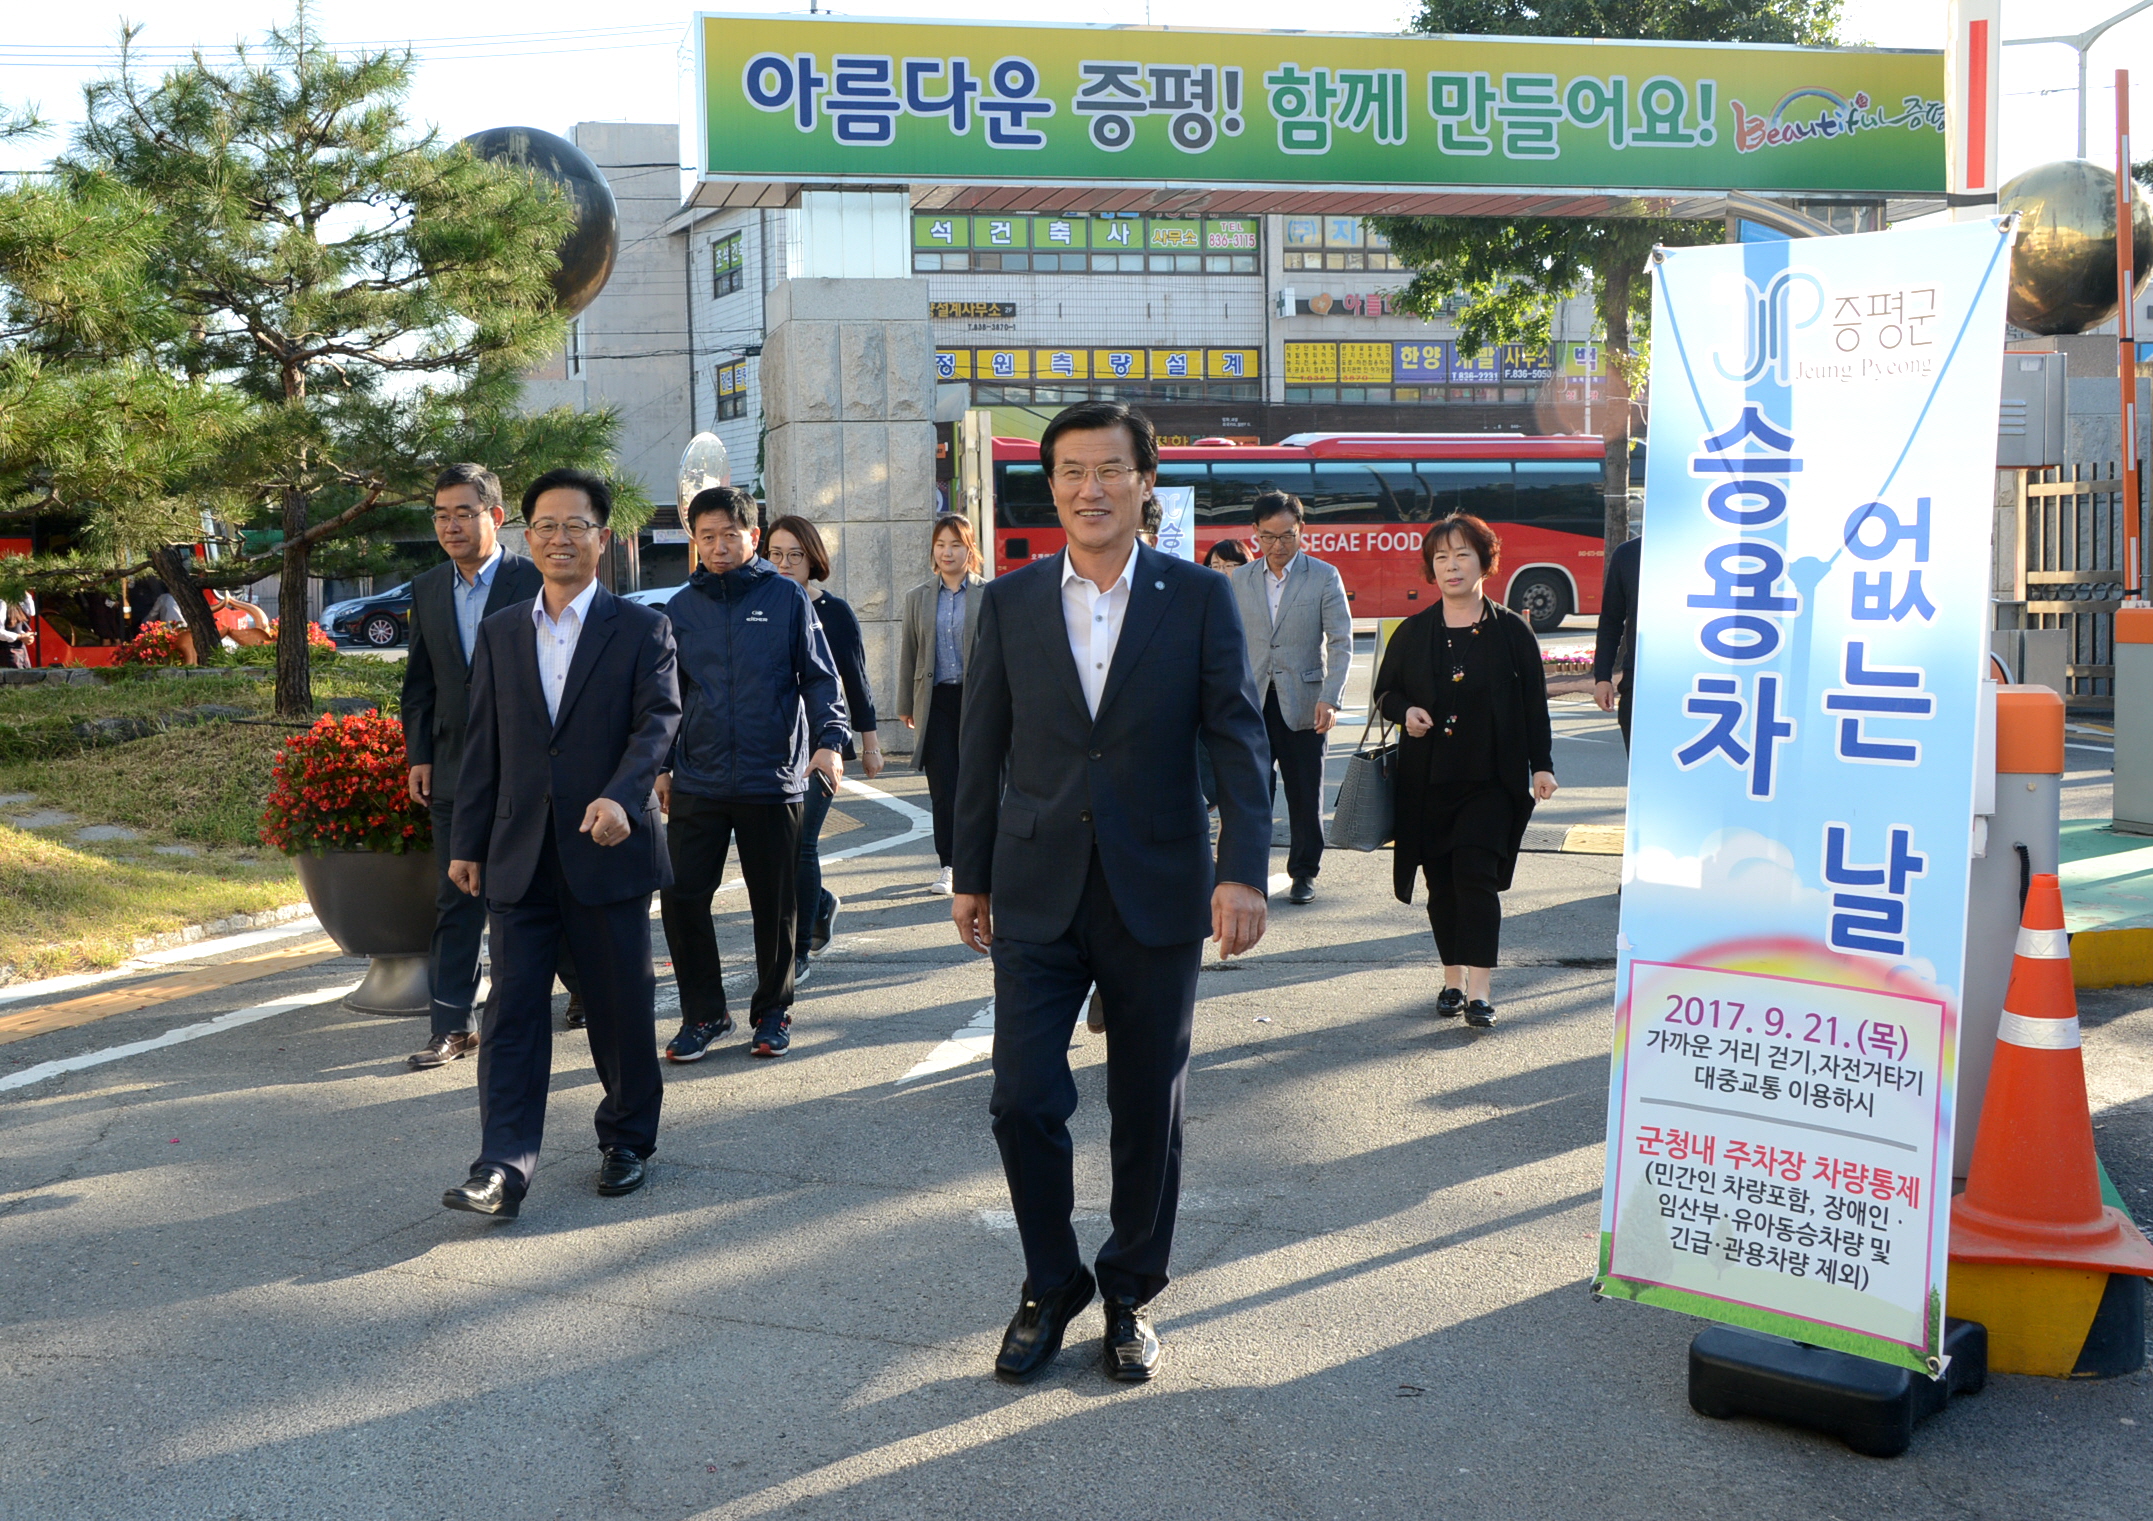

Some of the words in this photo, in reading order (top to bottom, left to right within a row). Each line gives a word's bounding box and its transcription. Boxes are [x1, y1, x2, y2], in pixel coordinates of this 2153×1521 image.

[743, 53, 1054, 149] 아름다운
[1073, 61, 1243, 153] 증평!
[1265, 63, 1406, 155] 함께
[1427, 70, 1716, 158] 만들어요!
[1152, 228, 1198, 247] 사무소
[1208, 233, 1257, 249] 836-3115
[1220, 221, 1244, 232] TEL
[1832, 288, 1937, 352] 증평군
[1401, 345, 1442, 370] 한양
[1861, 357, 1933, 381] Pyeong
[1367, 532, 1424, 551] FOOD
[1674, 405, 1805, 798] 승용차
[1823, 495, 1938, 765] 없는
[1822, 824, 1925, 958] 날
[1646, 1029, 1712, 1059] 가까운
[1718, 1037, 1760, 1067] 거리
[1694, 1065, 1782, 1101] 대중교통
[1789, 1080, 1875, 1118] 이용하시
[1636, 1125, 1715, 1164] 군청내
[1723, 1139, 1806, 1182] 주차장
[1812, 1156, 1921, 1210] 차량통제
[1644, 1160, 1716, 1196] (민간인
[1722, 1173, 1816, 1217] 차량포함,
[1870, 1238, 1891, 1265] 및
[1814, 1262, 1870, 1292] 제외)
